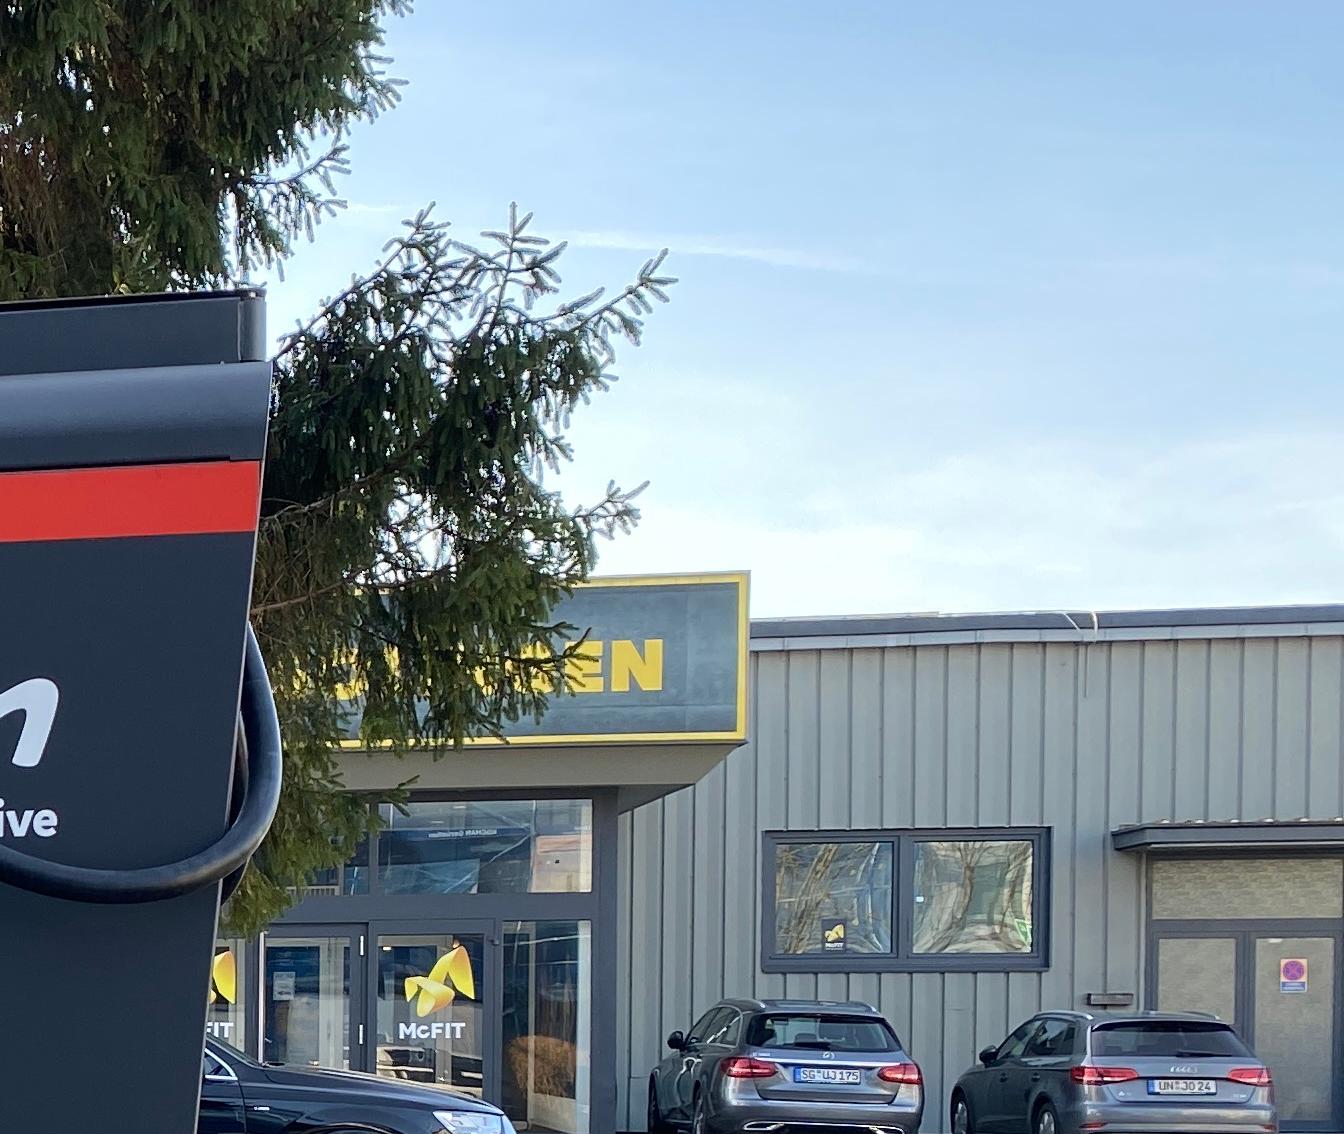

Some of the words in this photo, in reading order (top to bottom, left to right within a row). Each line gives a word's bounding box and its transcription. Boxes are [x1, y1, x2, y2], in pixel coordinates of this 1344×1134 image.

[398, 1022, 466, 1040] McFIT
[802, 1069, 816, 1080] SG
[839, 1071, 859, 1082] 175
[1158, 1080, 1173, 1091] UN
[1197, 1080, 1211, 1091] 24
